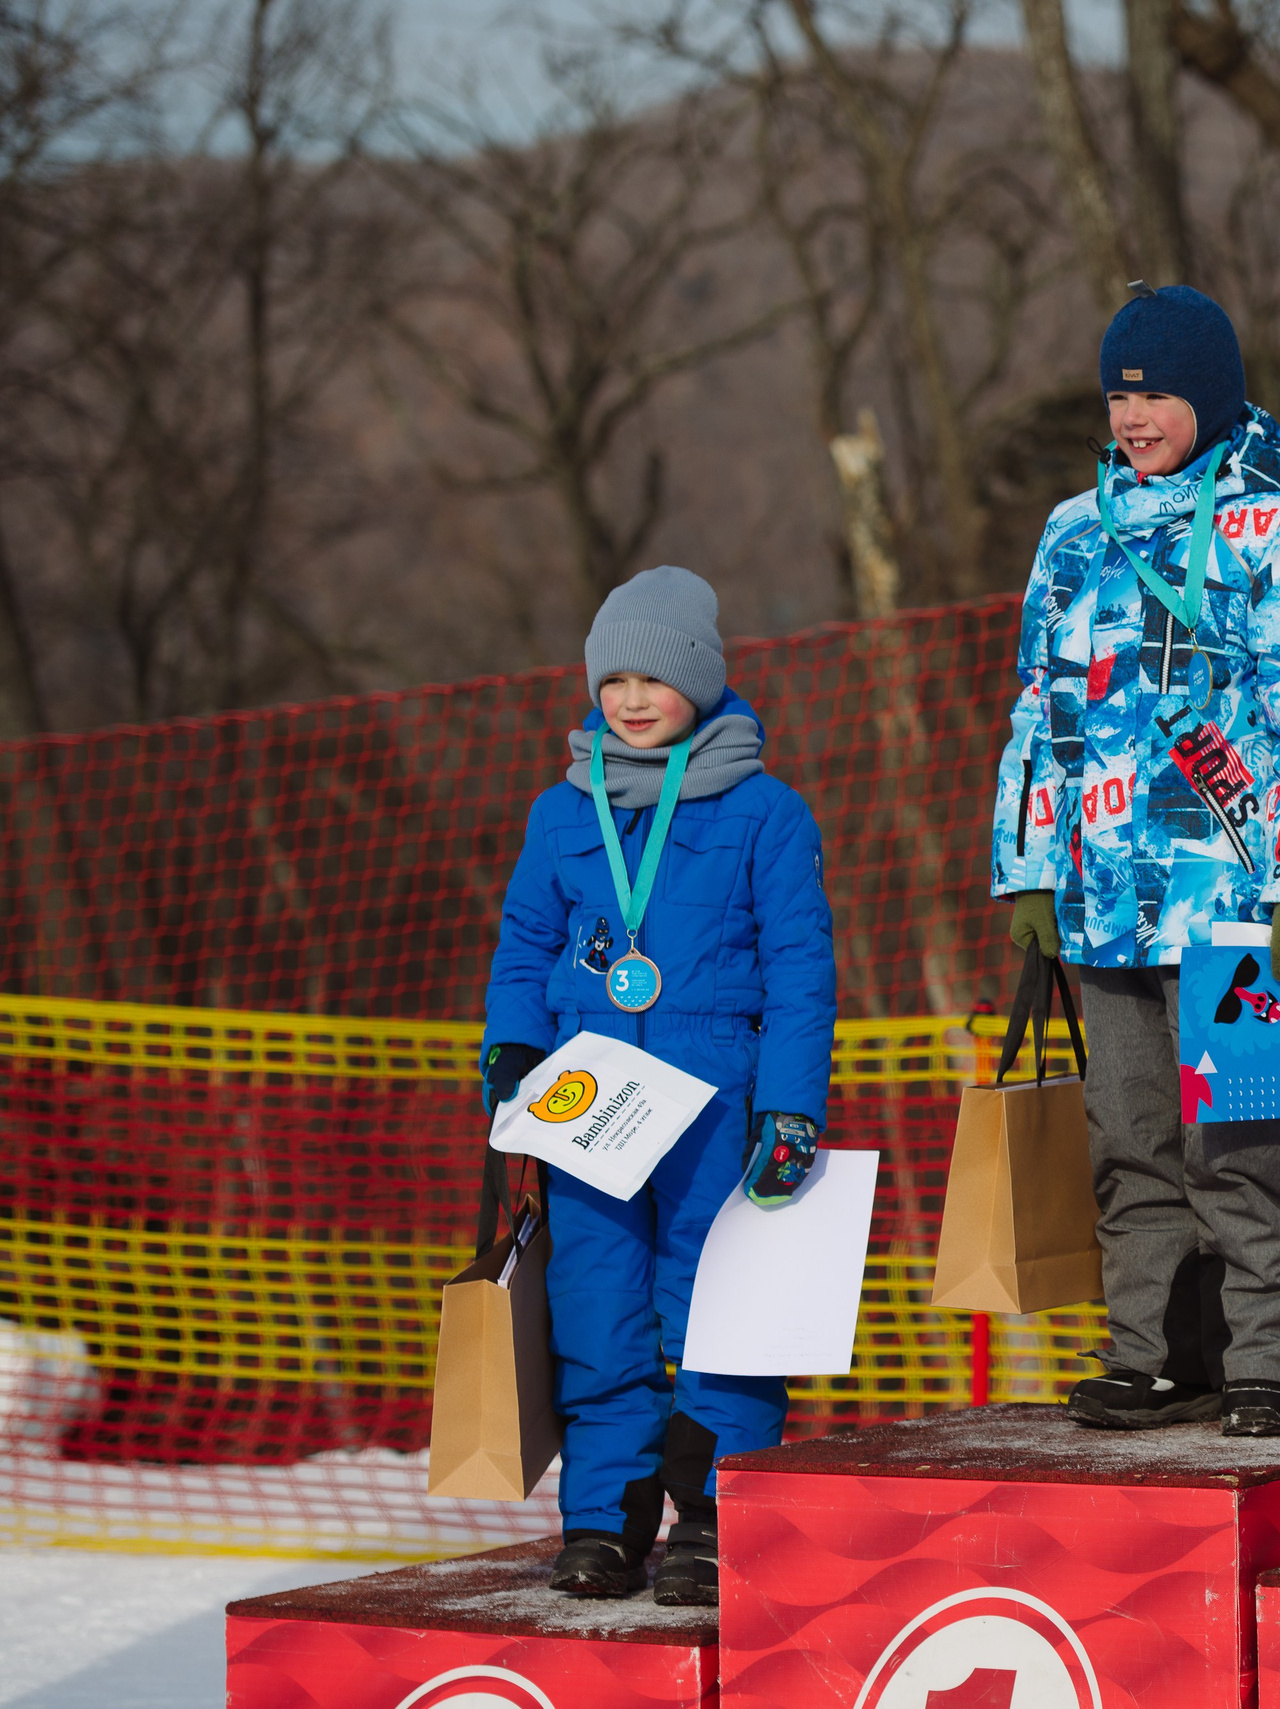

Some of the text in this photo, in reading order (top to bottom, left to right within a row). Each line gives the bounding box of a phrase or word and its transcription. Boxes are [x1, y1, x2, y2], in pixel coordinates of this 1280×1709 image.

[1155, 703, 1260, 828] SPORT
[615, 970, 629, 992] 3
[571, 1081, 641, 1150] Bambinizon
